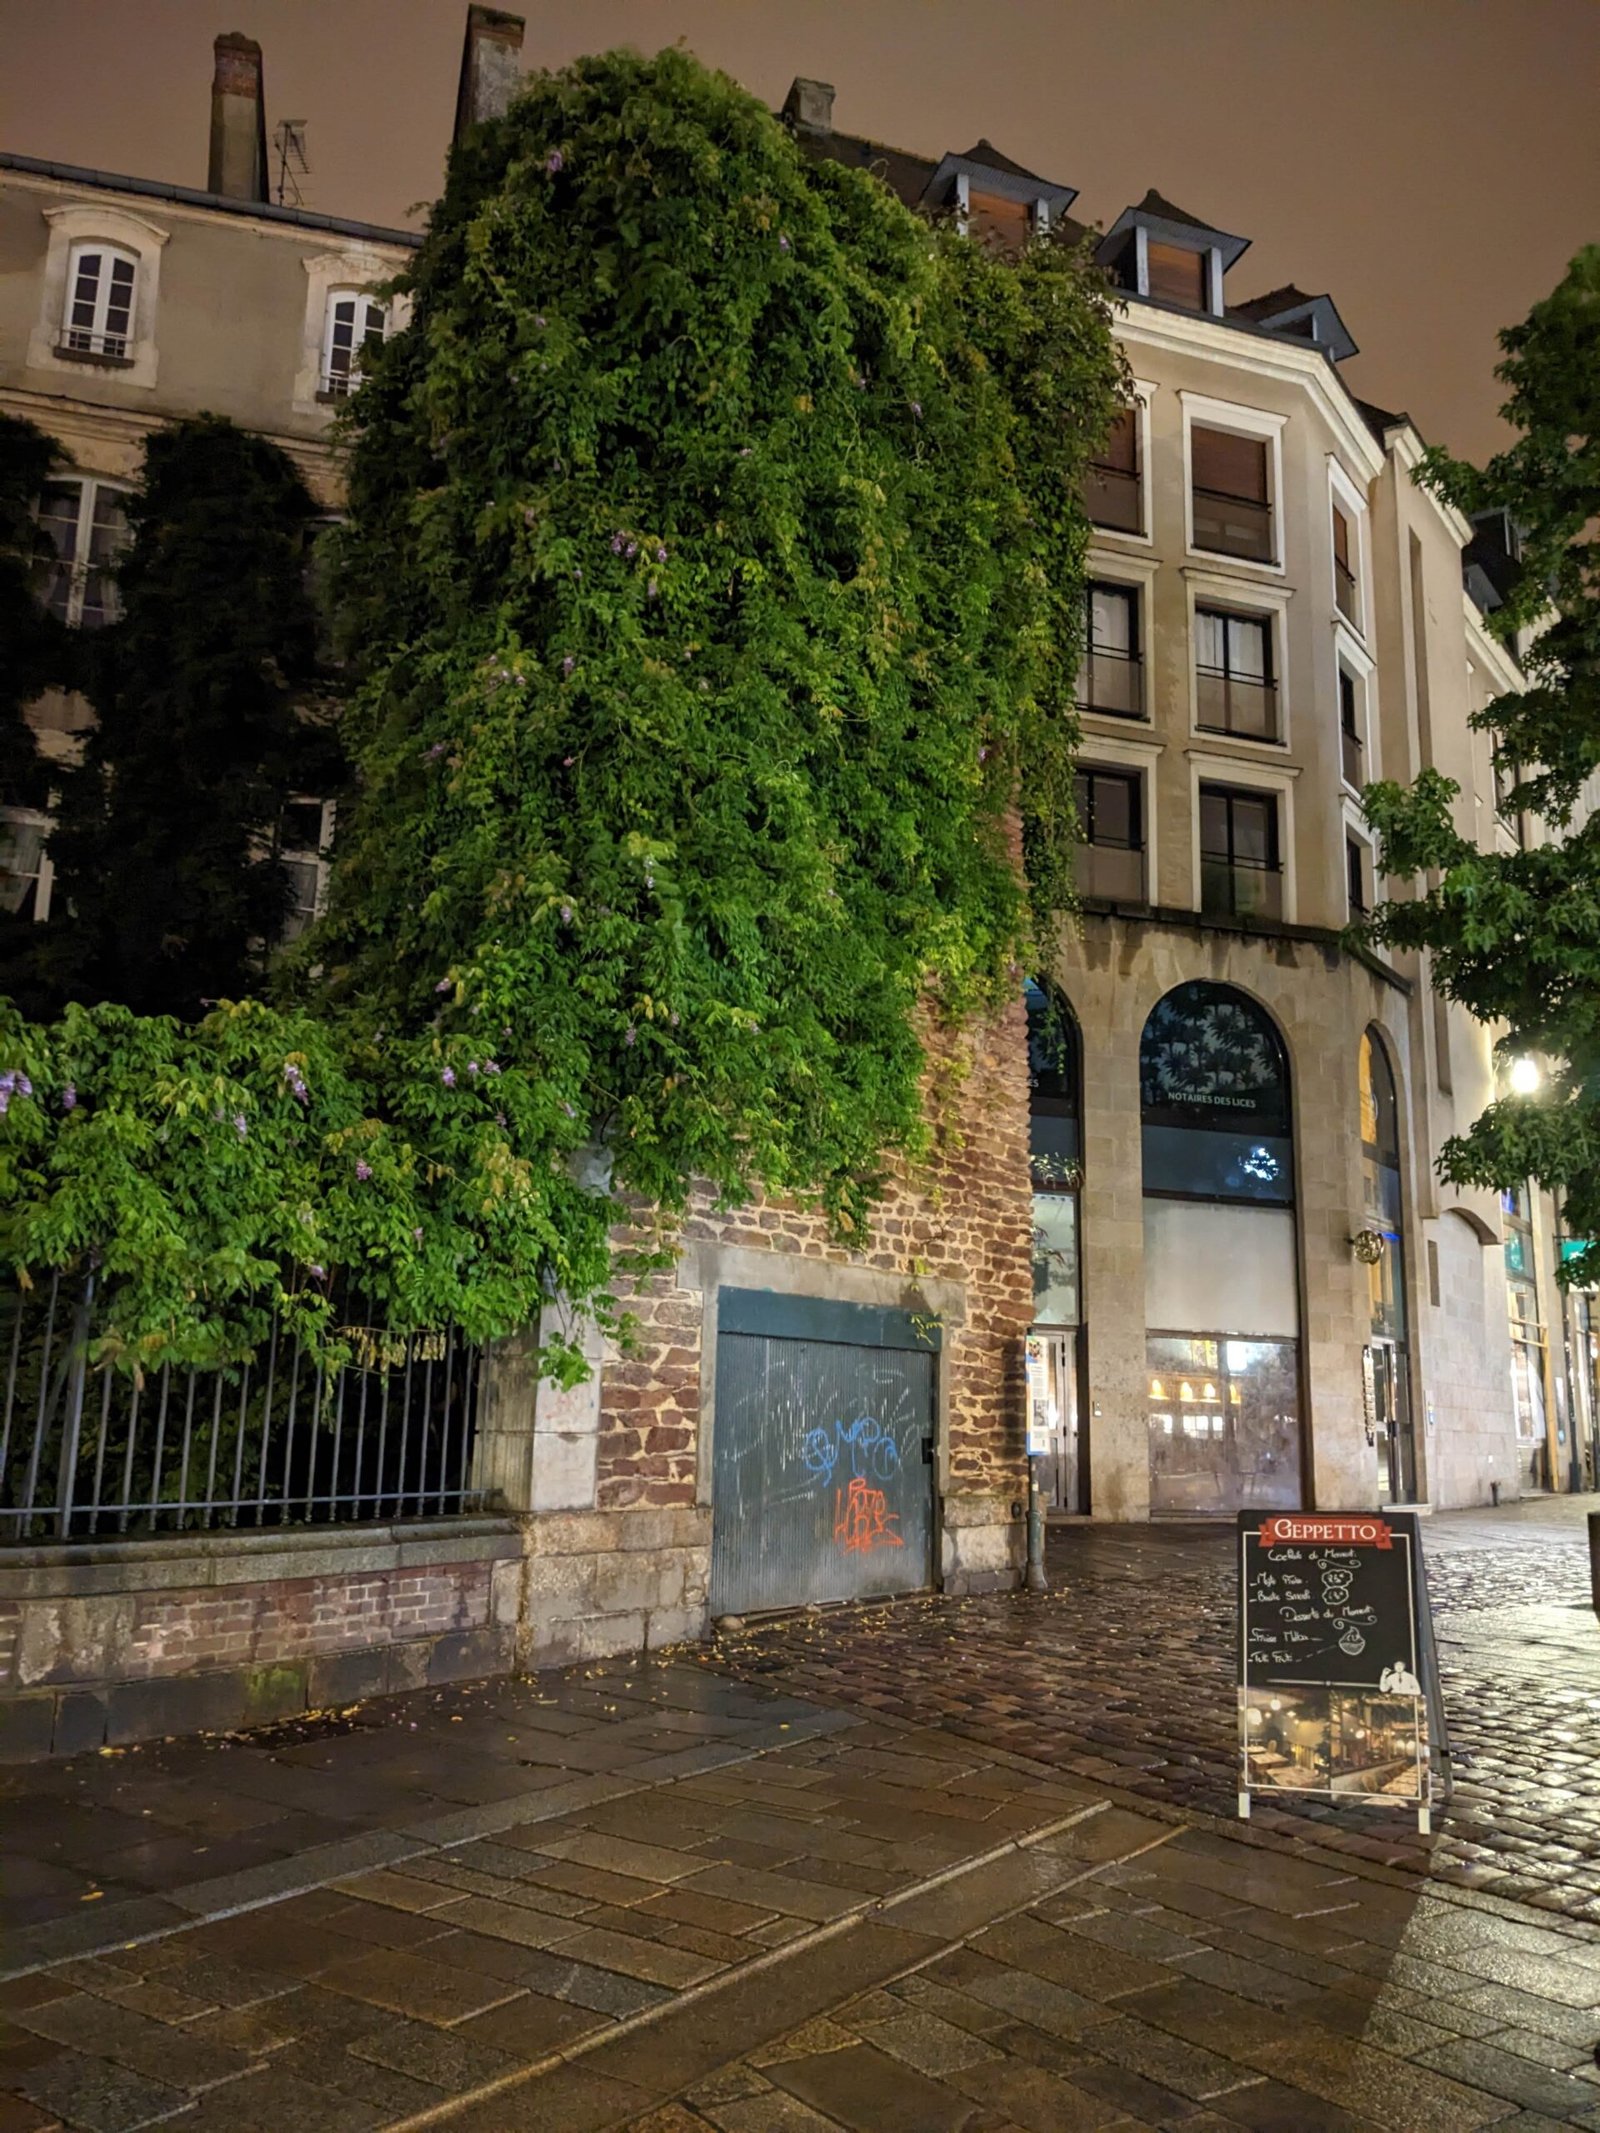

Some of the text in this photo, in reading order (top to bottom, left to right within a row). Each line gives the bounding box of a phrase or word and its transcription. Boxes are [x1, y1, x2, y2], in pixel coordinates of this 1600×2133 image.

[1168, 1092, 1256, 1108] NOTAIRES DES LICES
[1274, 1518, 1377, 1540] GEPPETTO
